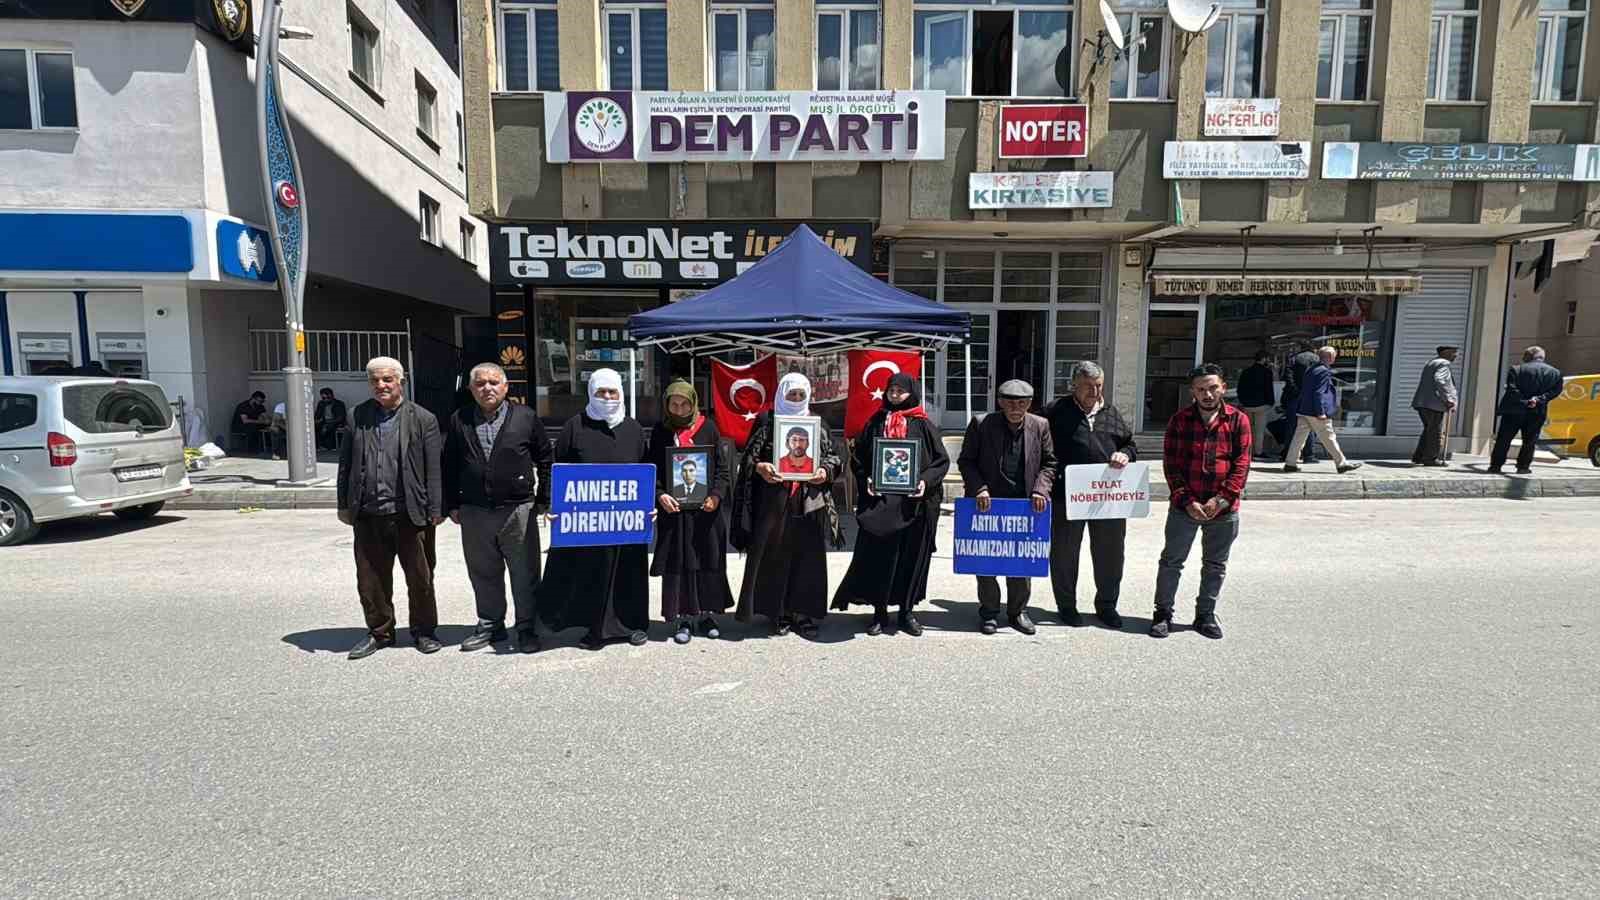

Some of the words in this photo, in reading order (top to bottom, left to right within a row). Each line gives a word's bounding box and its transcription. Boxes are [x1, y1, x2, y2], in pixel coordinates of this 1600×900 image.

[810, 105, 833, 115] MUŞ
[836, 102, 845, 114] İL
[849, 102, 897, 114] ÖRGÜTÜ
[651, 115, 753, 152] DEM
[769, 101, 919, 151] PARTİ
[1005, 120, 1082, 142] NOTER
[973, 186, 1109, 204] KIRTASİYE
[500, 227, 734, 259] TeknoNet
[564, 480, 639, 503] ANNELER
[1091, 480, 1122, 489] EVLAT
[1070, 490, 1145, 503] NÖBETİNDEYİZ
[560, 505, 645, 534] DİRENİYOR
[971, 514, 999, 532] ARTIK
[1001, 515, 1028, 533] YETER
[954, 539, 1015, 558] YAKAMIZDAN
[1017, 536, 1051, 563] DÜŞÜN
